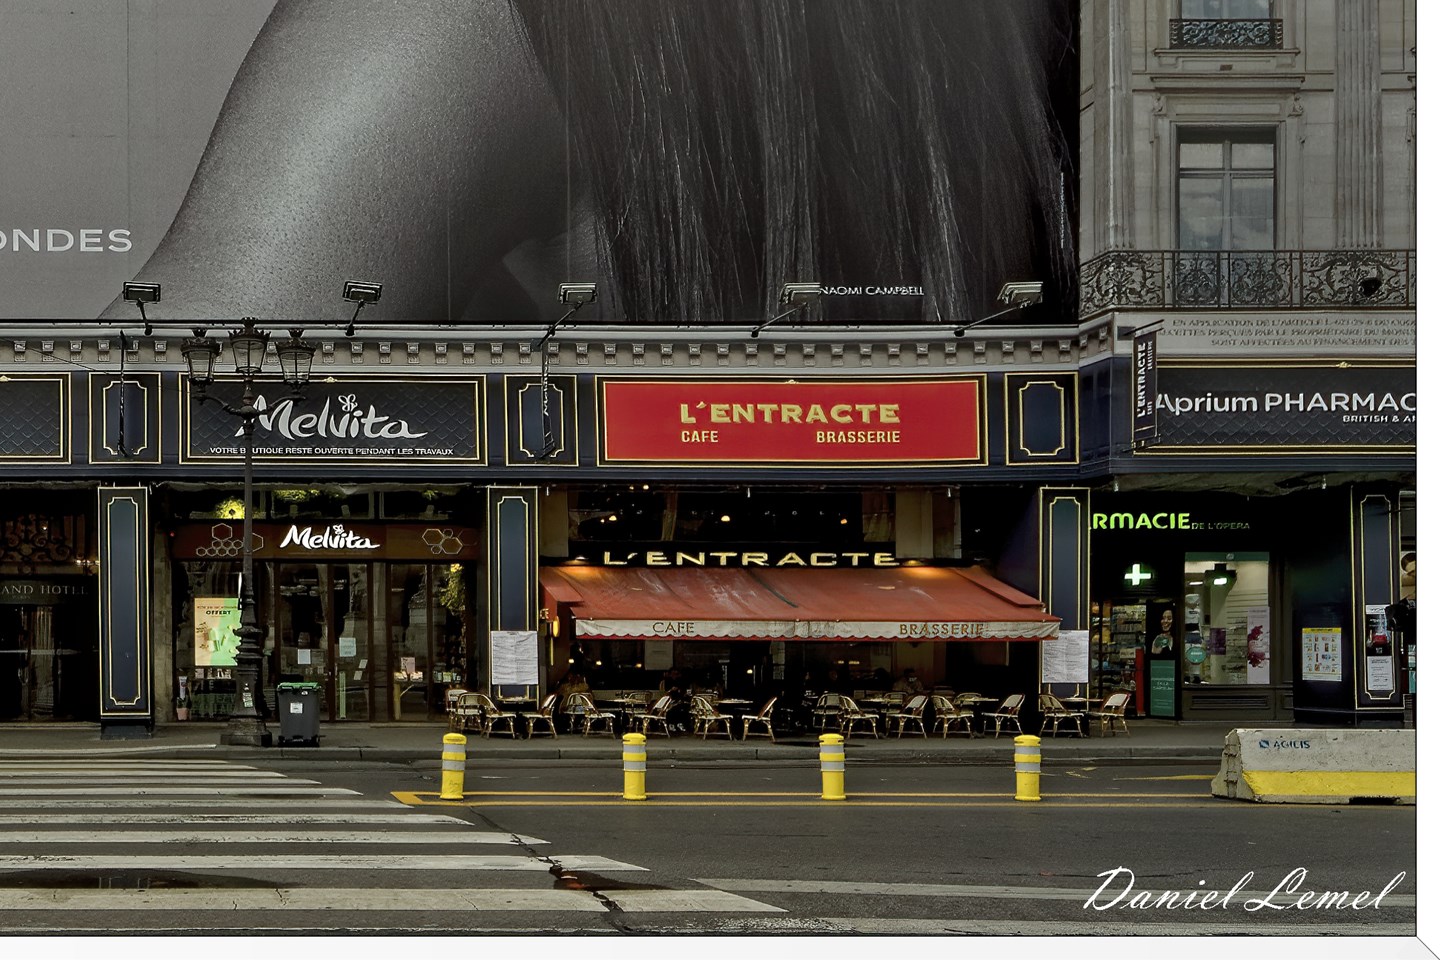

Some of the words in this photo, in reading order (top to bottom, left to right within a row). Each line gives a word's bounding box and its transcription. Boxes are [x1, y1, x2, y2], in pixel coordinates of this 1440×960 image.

[819, 286, 863, 295] NAOMI
[865, 286, 925, 296] CAMPBELL
[1156, 392, 1258, 416] Aprium
[234, 394, 428, 441] Melvita
[680, 401, 901, 424] L'ENTRACTE
[1342, 414, 1389, 423] BRITISH
[680, 430, 719, 443] CAFE
[815, 430, 901, 443] BRASSERIE
[285, 447, 313, 455] RESTE
[314, 447, 354, 455] OUVERTE
[415, 448, 454, 456] TRAVAUX
[1091, 512, 1191, 530] RMACIE
[279, 524, 381, 550] Melvita
[603, 551, 900, 566] L'ENTRACTE
[652, 621, 695, 634] CAFE
[899, 623, 985, 635] BRASSERIE
